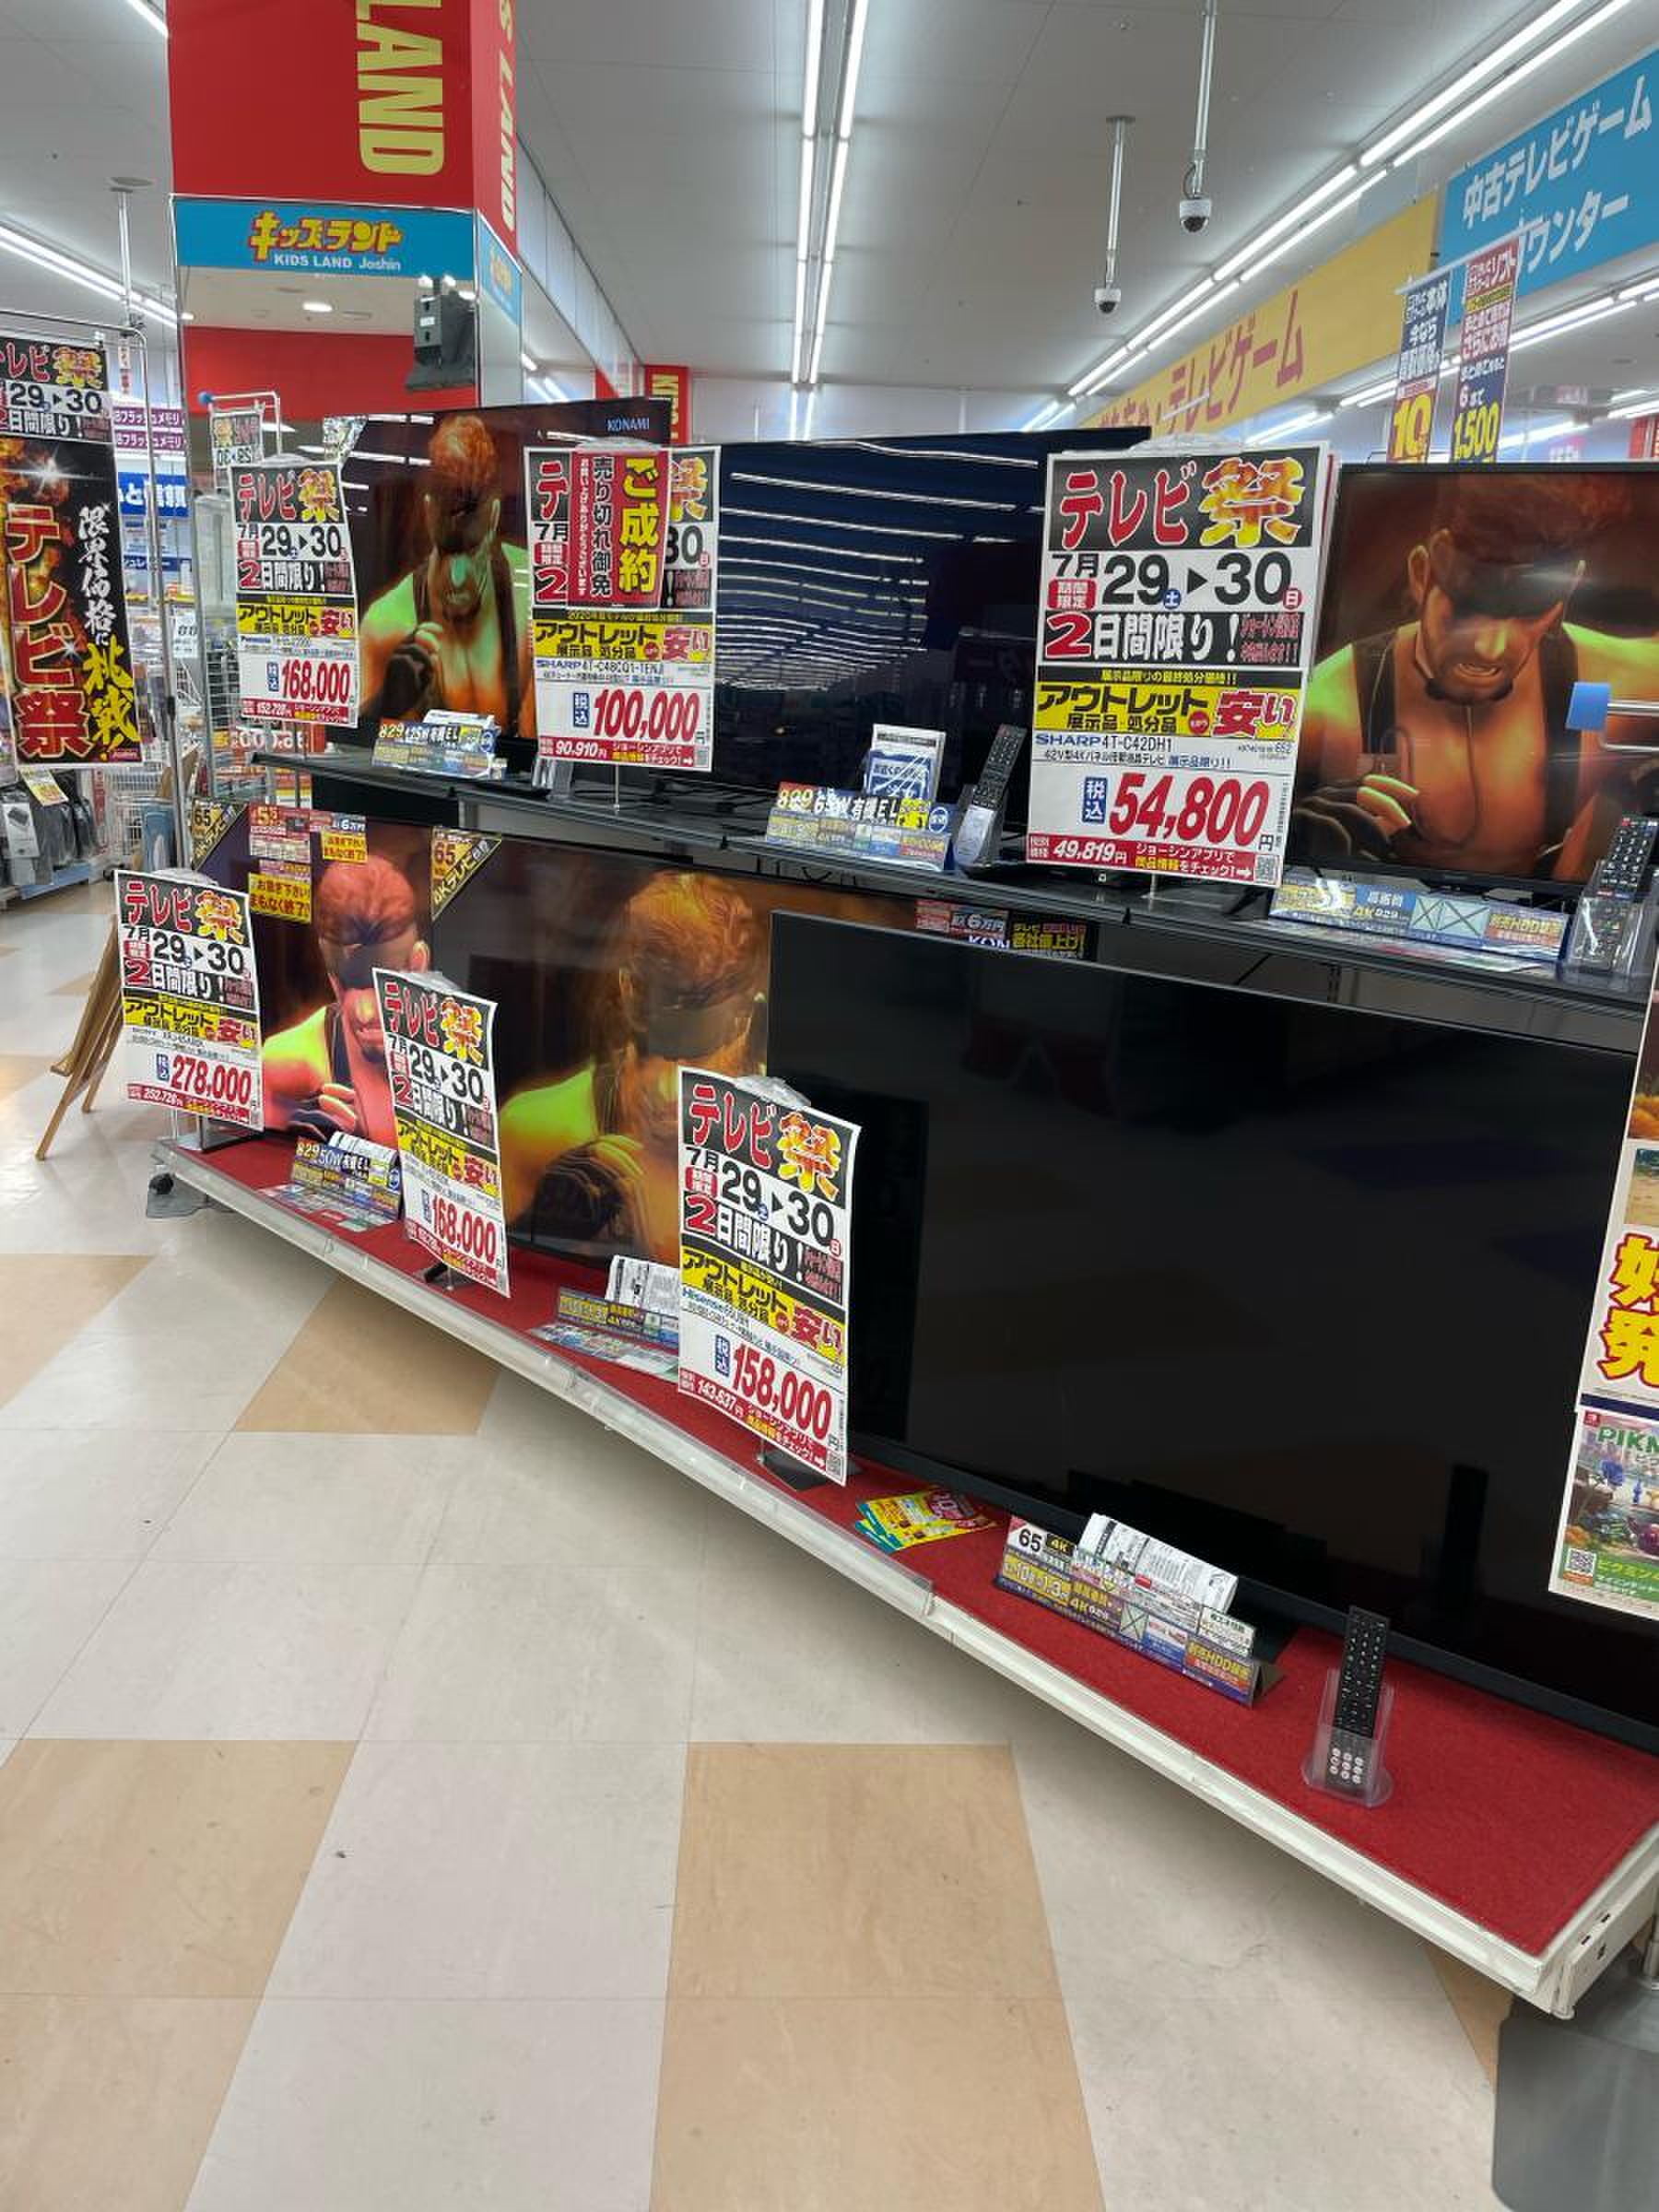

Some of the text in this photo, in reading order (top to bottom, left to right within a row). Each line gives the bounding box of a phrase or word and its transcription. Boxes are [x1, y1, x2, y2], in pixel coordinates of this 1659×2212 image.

[356, 0, 444, 176] LAND
[1464, 75, 1653, 229] 中古テレビゲーム
[274, 253, 401, 271] KIDS LAND Joshin
[0, 342, 104, 389] レビ祭
[10, 382, 102, 415] 29 30
[237, 468, 340, 524] テレビ祭
[1061, 457, 1307, 550] テレビ祭
[262, 525, 292, 557] 29
[311, 525, 342, 558] 30
[589, 456, 615, 597] 売り切れ御免
[618, 457, 661, 594] ご成約
[1052, 553, 1100, 579] 7月
[1102, 554, 1170, 606] 29
[1214, 551, 1292, 606] 30
[6, 503, 93, 759] テレビ祭
[238, 605, 317, 625] アウトレット
[535, 622, 710, 662] アウトレット 安い
[281, 659, 351, 704] 168,000
[593, 688, 700, 741] 100,000
[1038, 685, 1209, 717] アウトレット
[1213, 690, 1297, 738] 安い
[1035, 734, 1173, 753] SHARP 4T-C42DH1
[1082, 775, 1106, 824] 税込
[1109, 772, 1270, 846] 54,800
[1053, 840, 1127, 865] 49,819円
[1135, 842, 1236, 865] ジョーシンアプリで
[124, 879, 245, 945] テレビ祭
[152, 931, 186, 962] 29
[207, 942, 243, 974] 30
[124, 998, 214, 1027] アウトレット
[384, 981, 485, 1067] テレビ祭
[171, 1054, 252, 1105] 278,000
[409, 1044, 435, 1084] 29
[451, 1062, 484, 1105] 30
[689, 1084, 841, 1202] テレビ祭
[686, 1146, 719, 1173] 7月
[722, 1160, 764, 1213] 29
[787, 1190, 835, 1248] 30
[433, 1194, 497, 1265] 168,000
[680, 1250, 788, 1313] アウトレット
[732, 1343, 832, 1441] 158,000
[1019, 1528, 1042, 1552] 65
